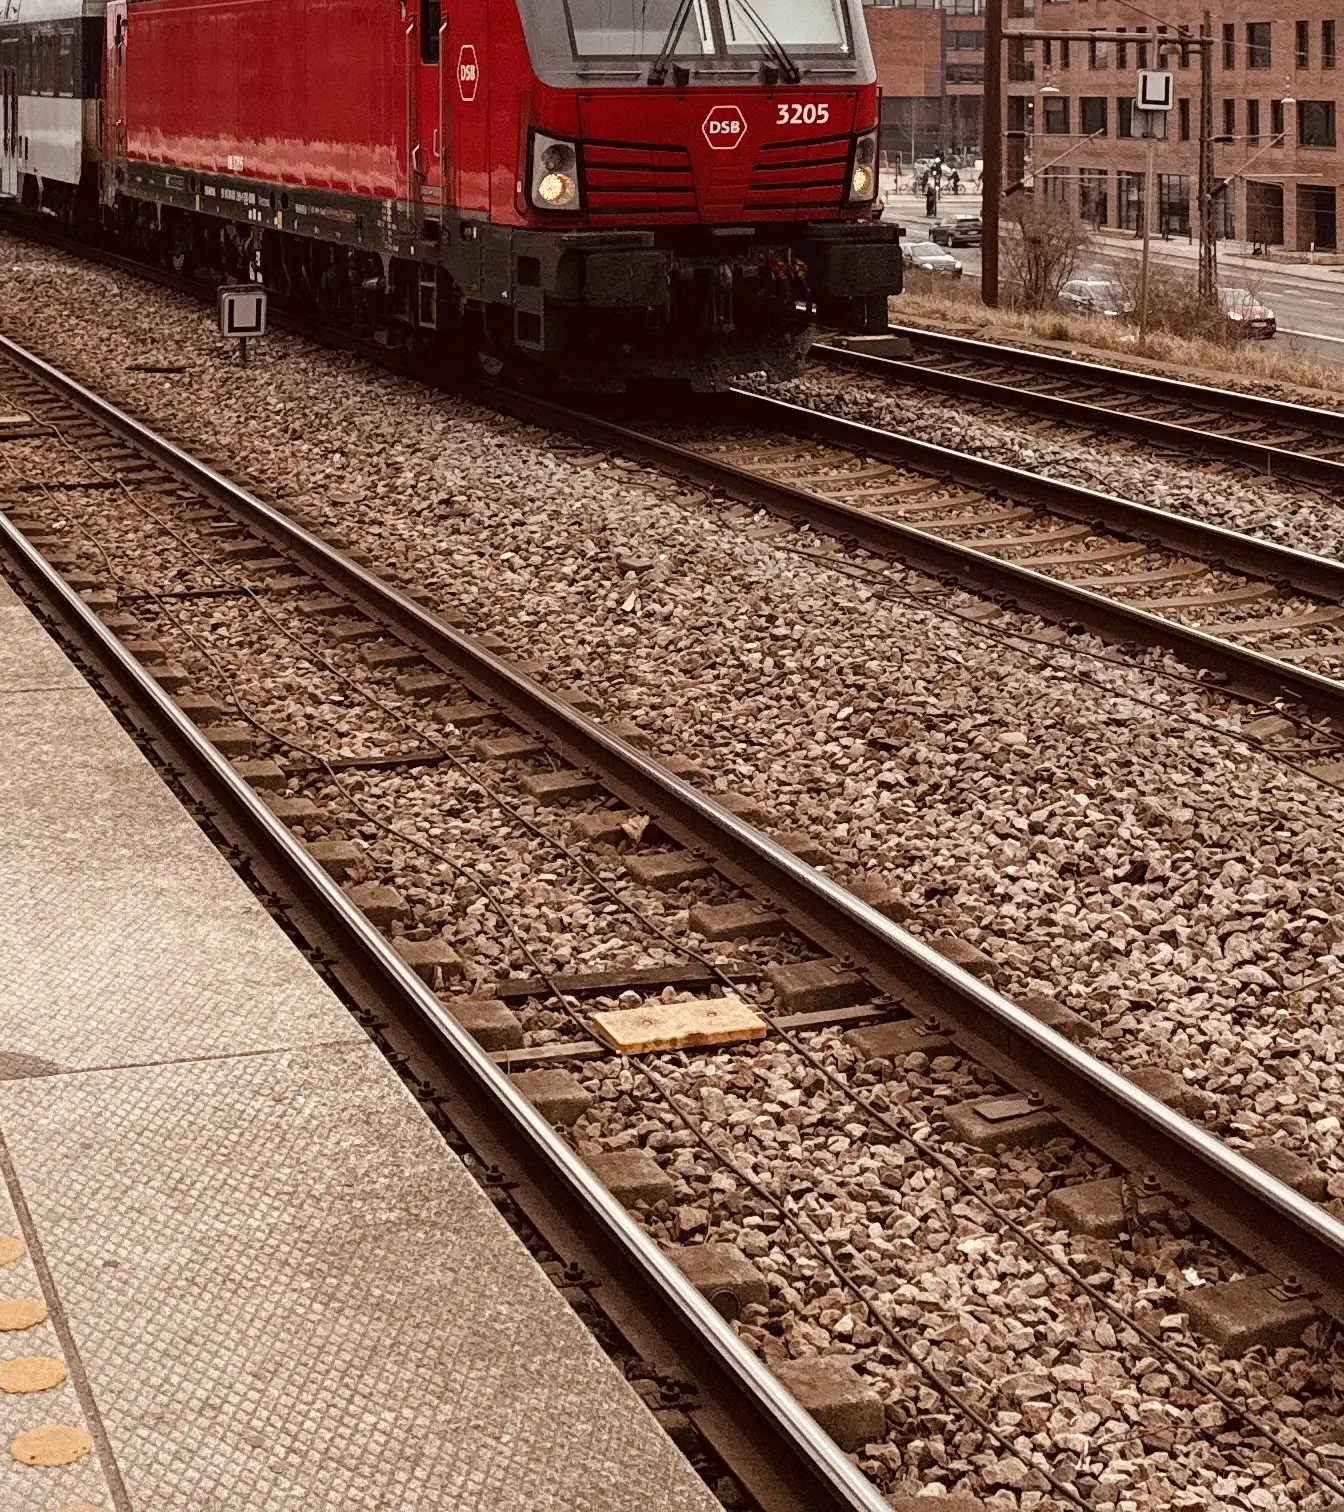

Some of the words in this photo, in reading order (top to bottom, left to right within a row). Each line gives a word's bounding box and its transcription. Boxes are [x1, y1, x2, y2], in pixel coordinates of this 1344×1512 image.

[460, 64, 476, 81] DSB
[776, 103, 830, 125] 3205
[709, 120, 741, 134] DSB
